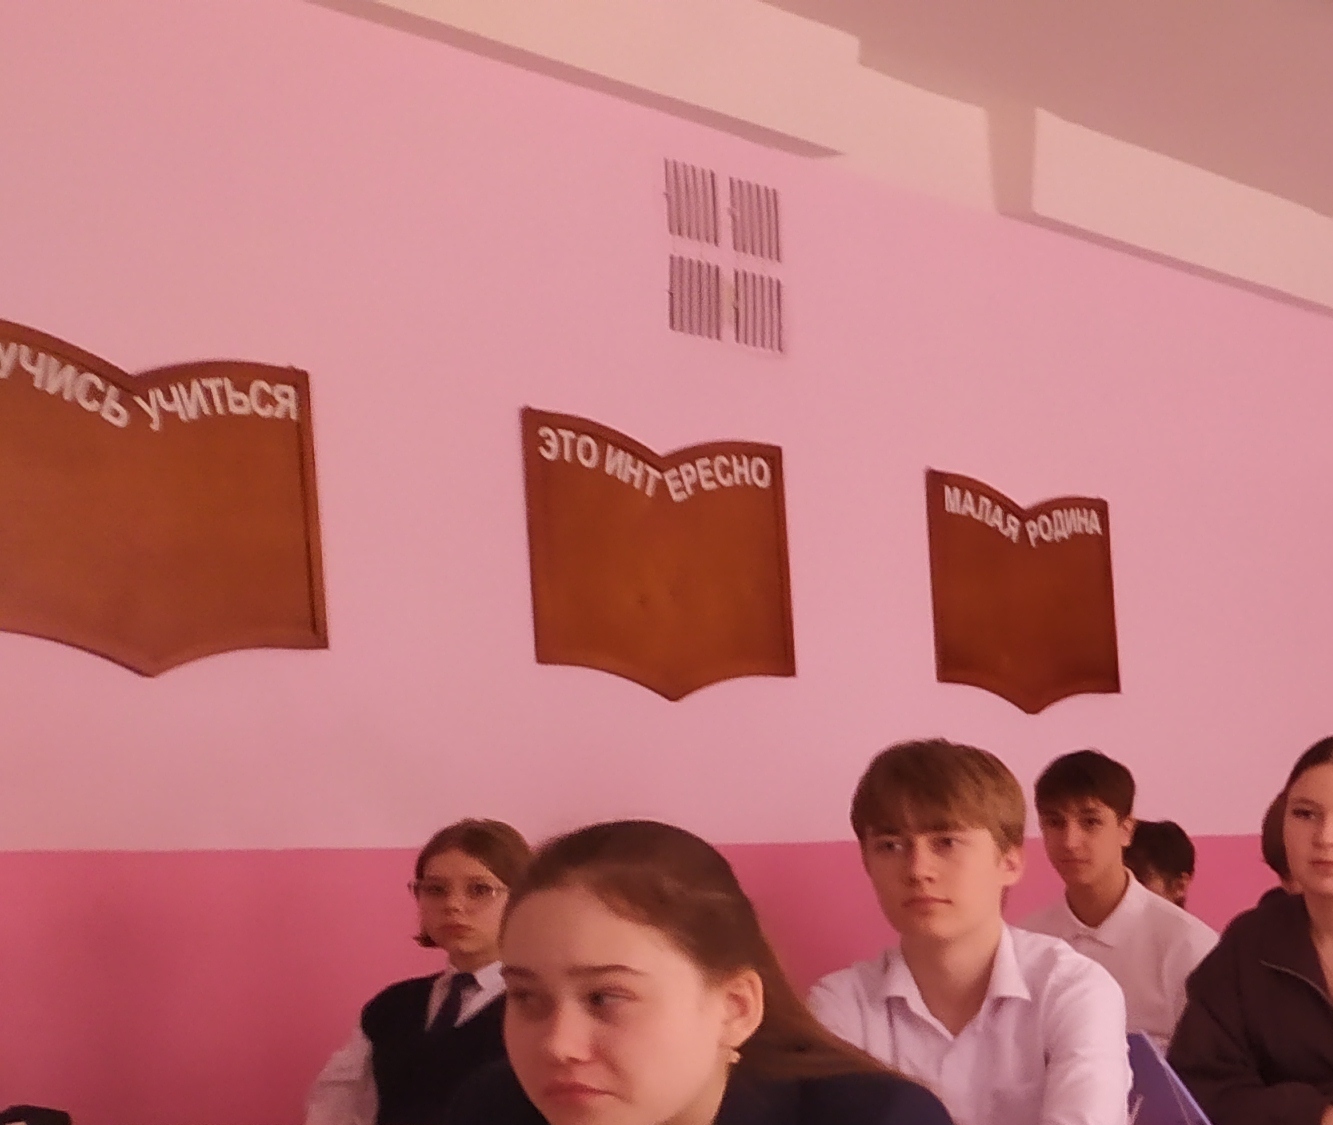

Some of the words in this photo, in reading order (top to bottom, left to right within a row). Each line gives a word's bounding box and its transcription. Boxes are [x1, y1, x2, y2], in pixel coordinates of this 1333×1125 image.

[0, 342, 129, 428] УЧИСЬ
[133, 377, 299, 431] УЧИТЬСЯ
[537, 426, 599, 469] ЭТО
[604, 442, 771, 502] ИНТЕРЕСНО
[944, 484, 1021, 543] МАЛАЯ
[1025, 507, 1103, 548] РОДИНА
